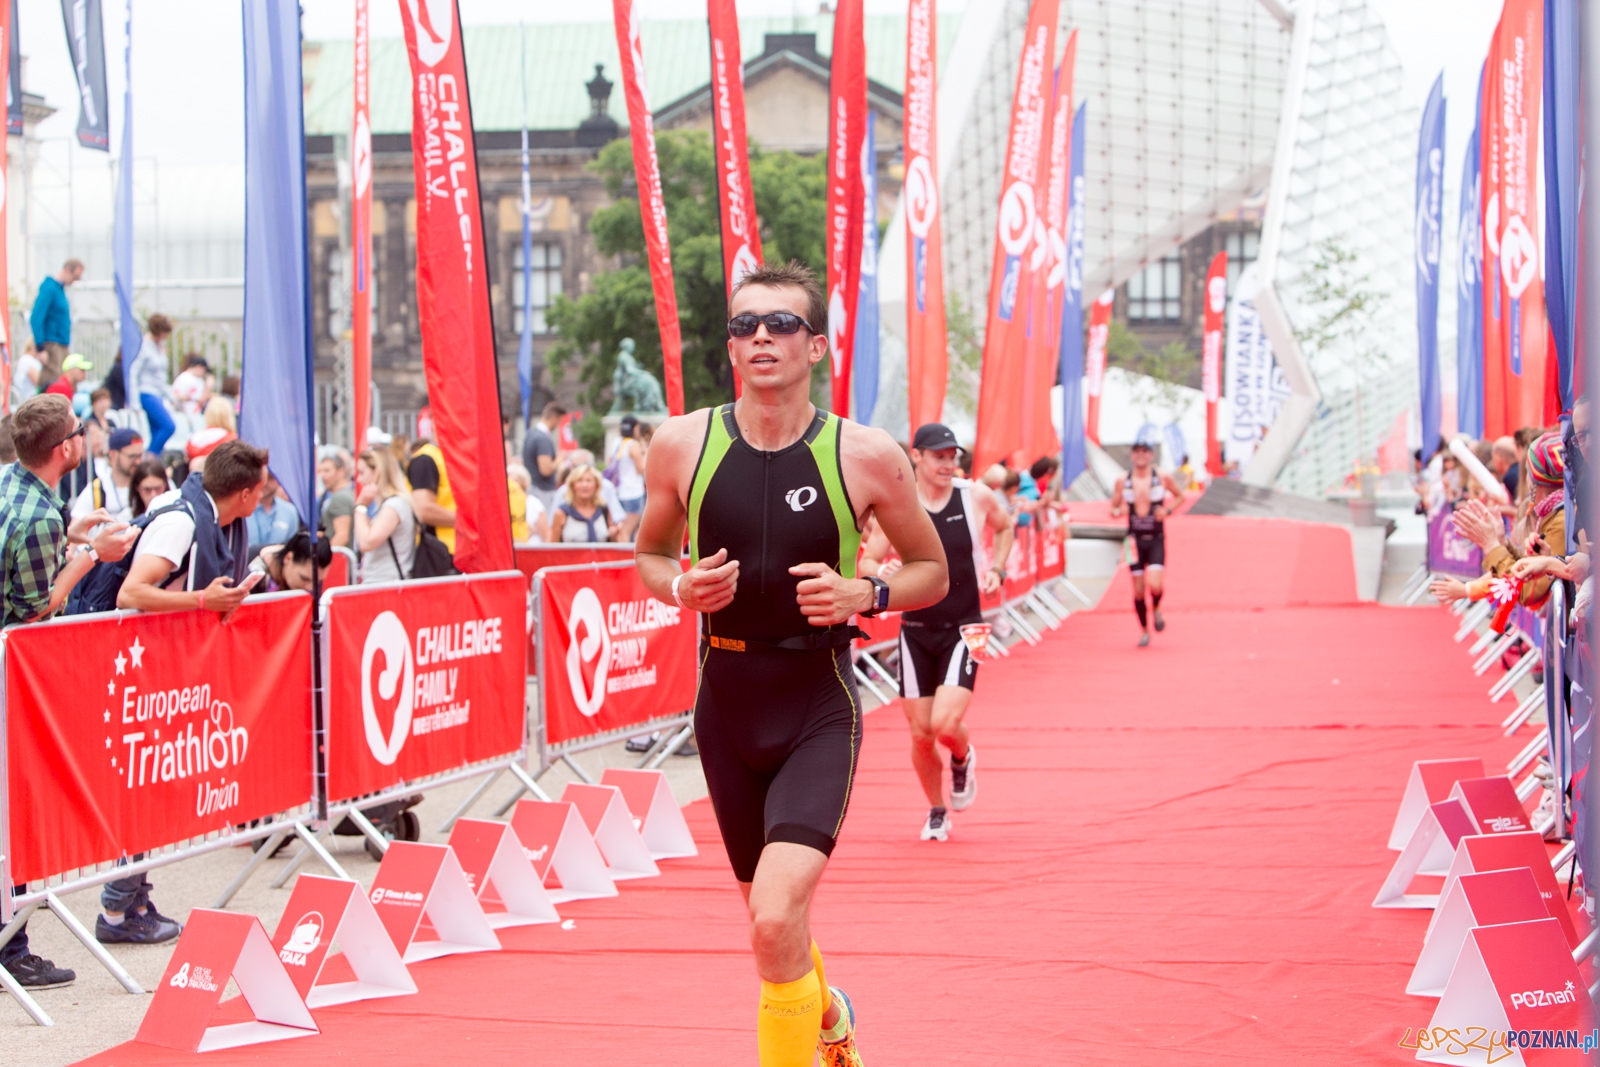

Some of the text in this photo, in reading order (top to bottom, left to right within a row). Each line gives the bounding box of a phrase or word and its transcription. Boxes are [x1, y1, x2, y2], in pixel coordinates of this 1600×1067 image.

[416, 617, 502, 666] CHALLENGE
[122, 683, 210, 725] European
[413, 667, 458, 710] FAMILY
[122, 719, 248, 789] Triathlon
[196, 776, 239, 817] Union
[768, 1004, 798, 1014] ROYAL
[801, 1002, 814, 1012] BAY
